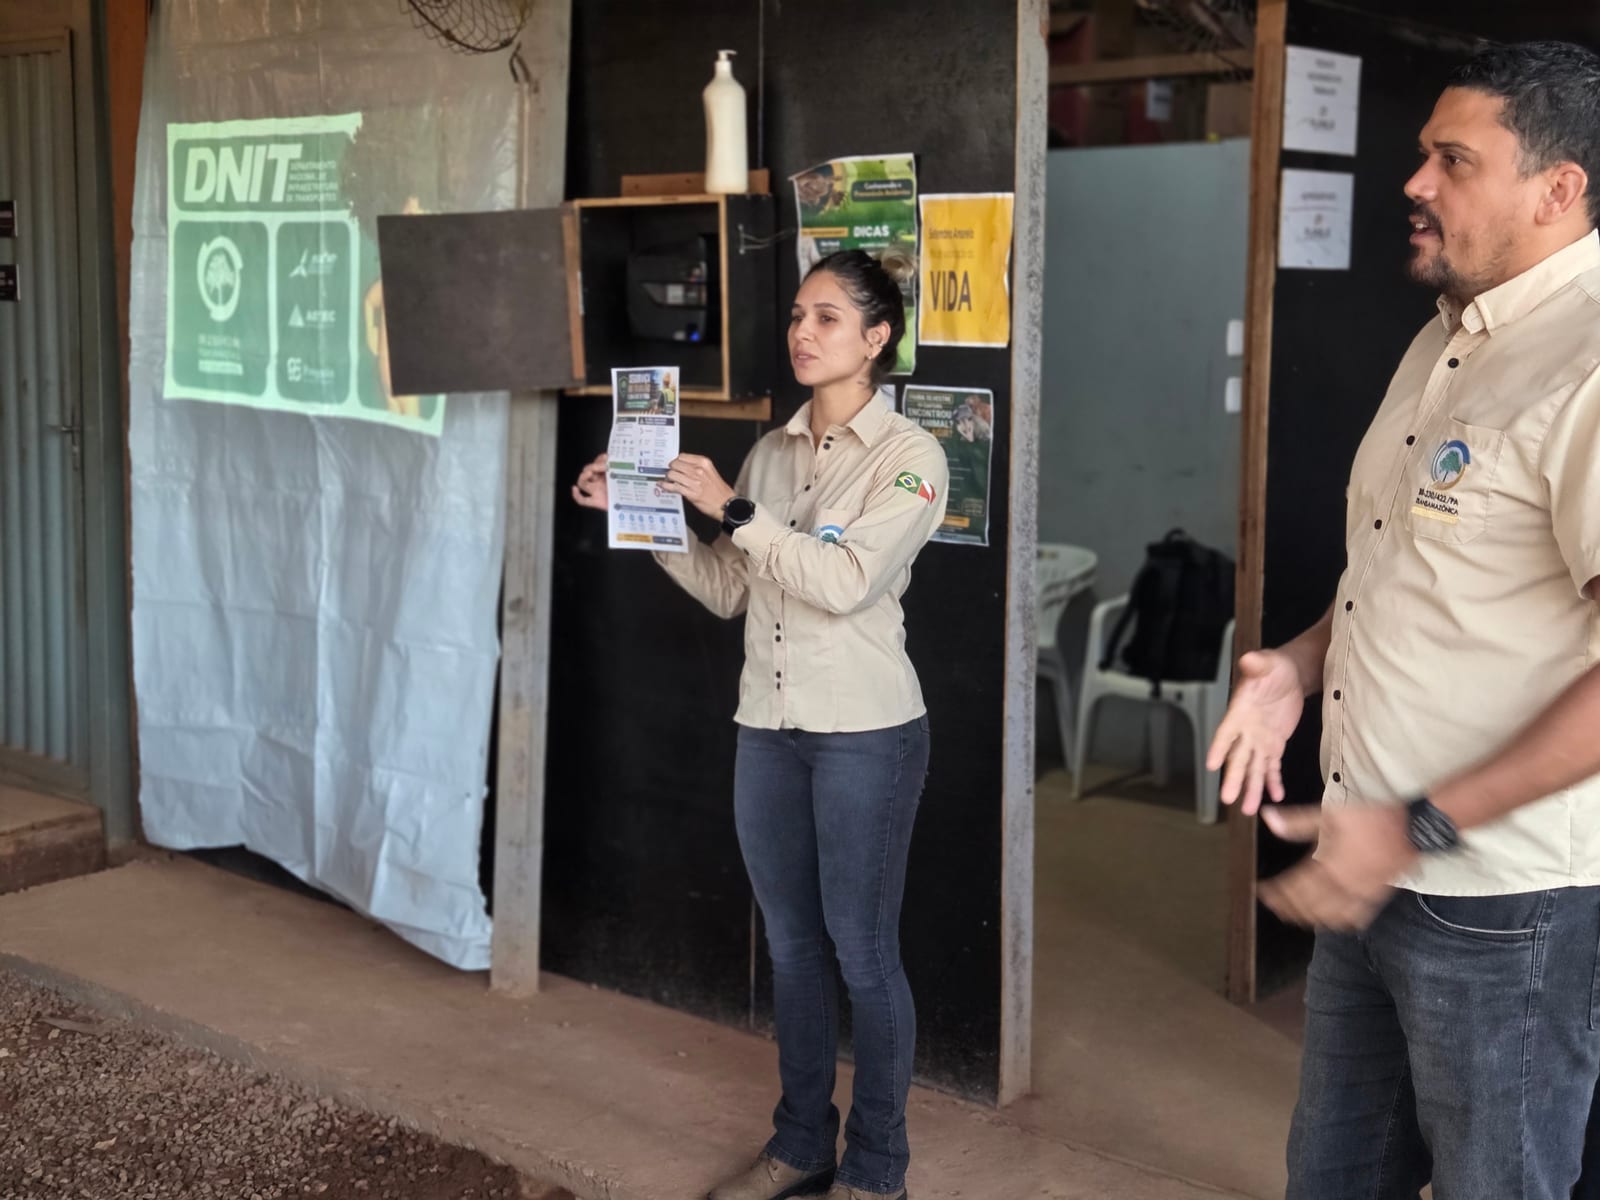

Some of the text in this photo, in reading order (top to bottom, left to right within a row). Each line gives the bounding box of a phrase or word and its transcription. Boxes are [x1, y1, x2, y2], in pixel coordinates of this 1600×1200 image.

[184, 143, 303, 203] DNIT
[853, 225, 890, 238] DICAS
[930, 270, 972, 312] VIDA
